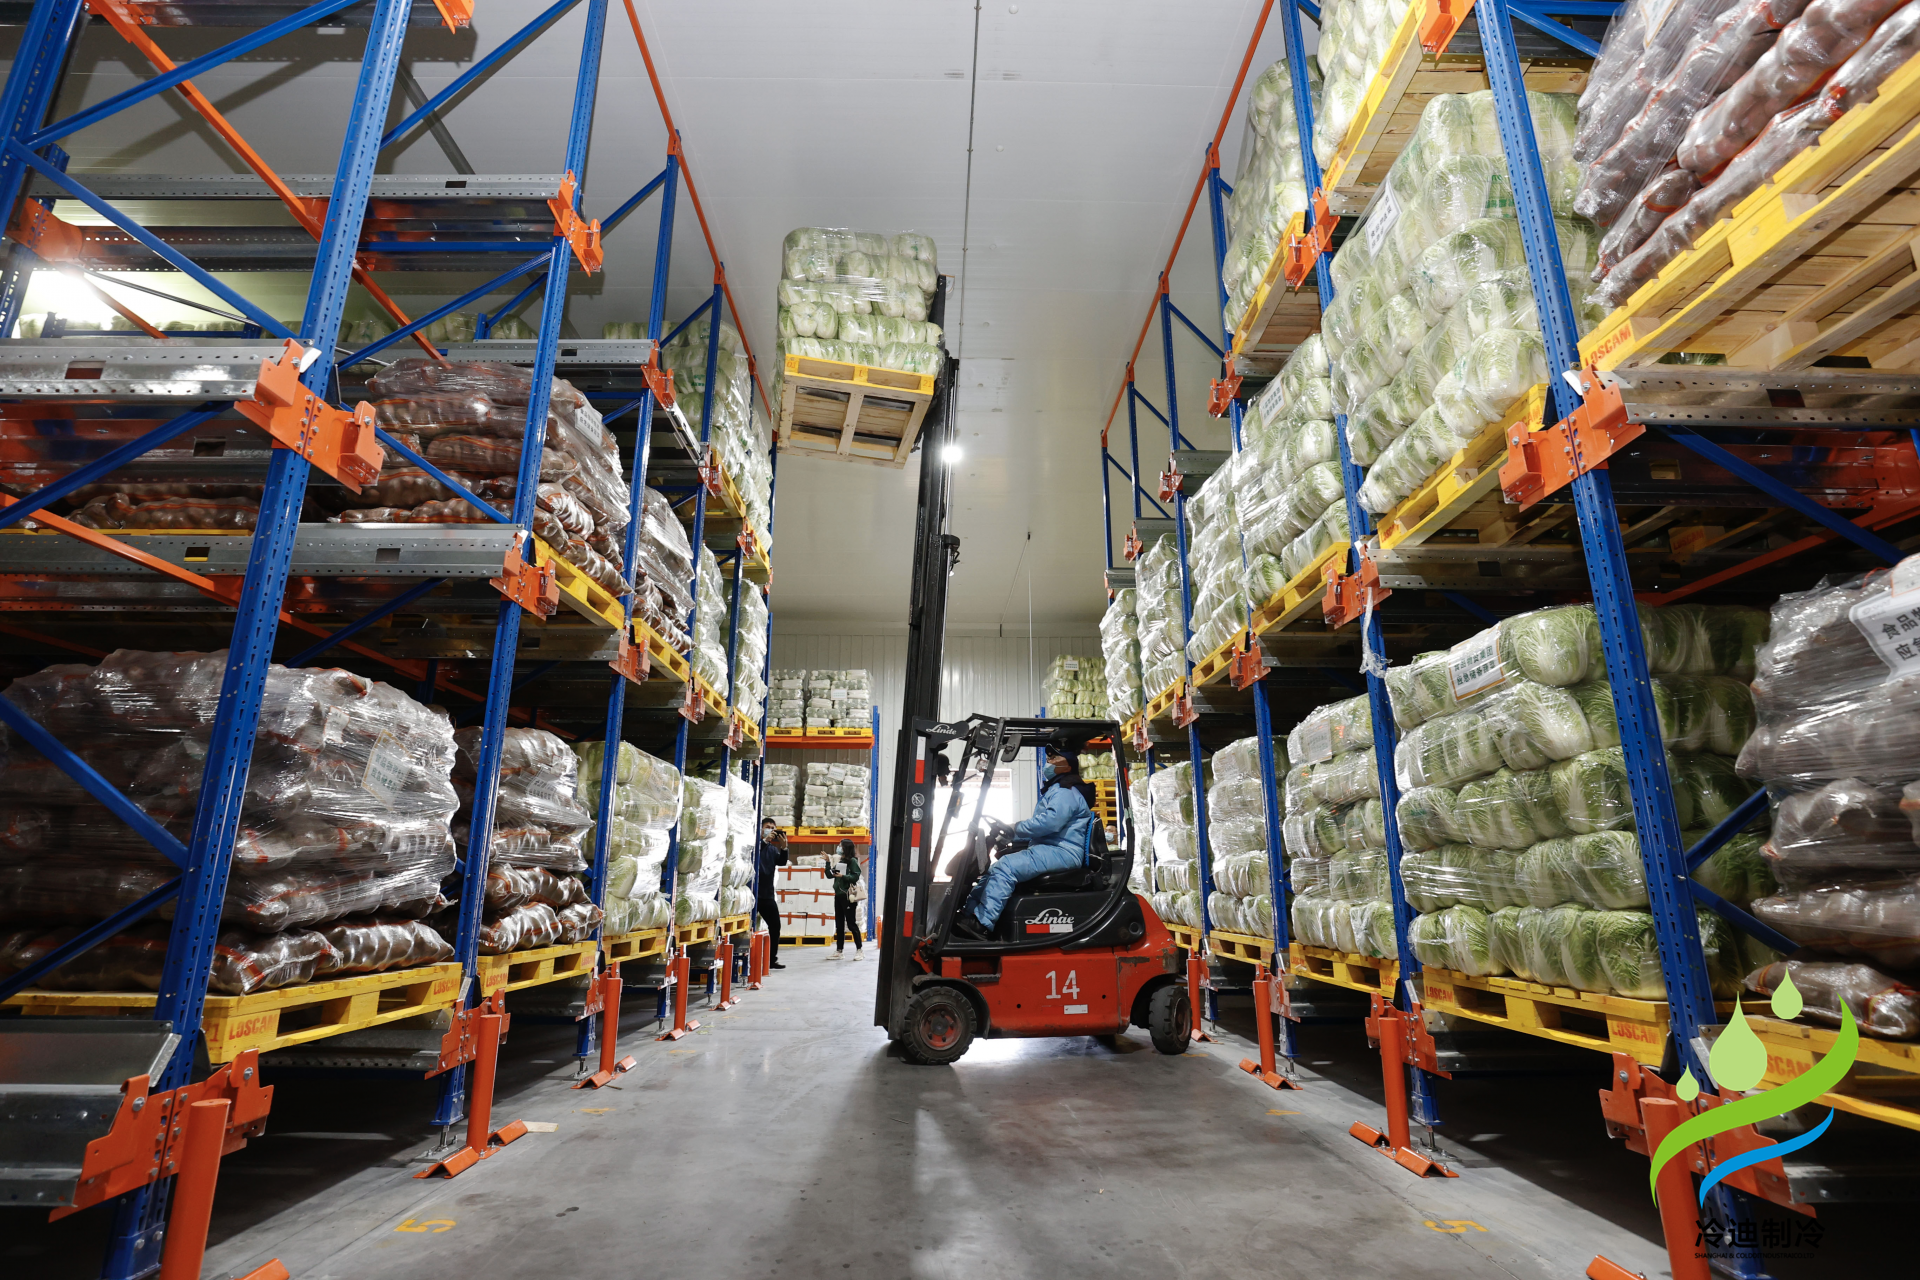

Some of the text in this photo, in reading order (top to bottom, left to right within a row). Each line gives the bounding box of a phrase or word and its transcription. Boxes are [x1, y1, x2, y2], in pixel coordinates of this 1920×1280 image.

[926, 724, 957, 735] Linde
[1025, 908, 1075, 925] Linde
[1045, 969, 1081, 1000] 14
[1425, 985, 1454, 1004] LOSCAM
[228, 1012, 280, 1041] LOSCAM
[1611, 1020, 1662, 1046] LOSCAM
[1766, 1053, 1812, 1078] SCAM
[393, 1219, 457, 1233] 5
[1424, 1219, 1489, 1234] 5
